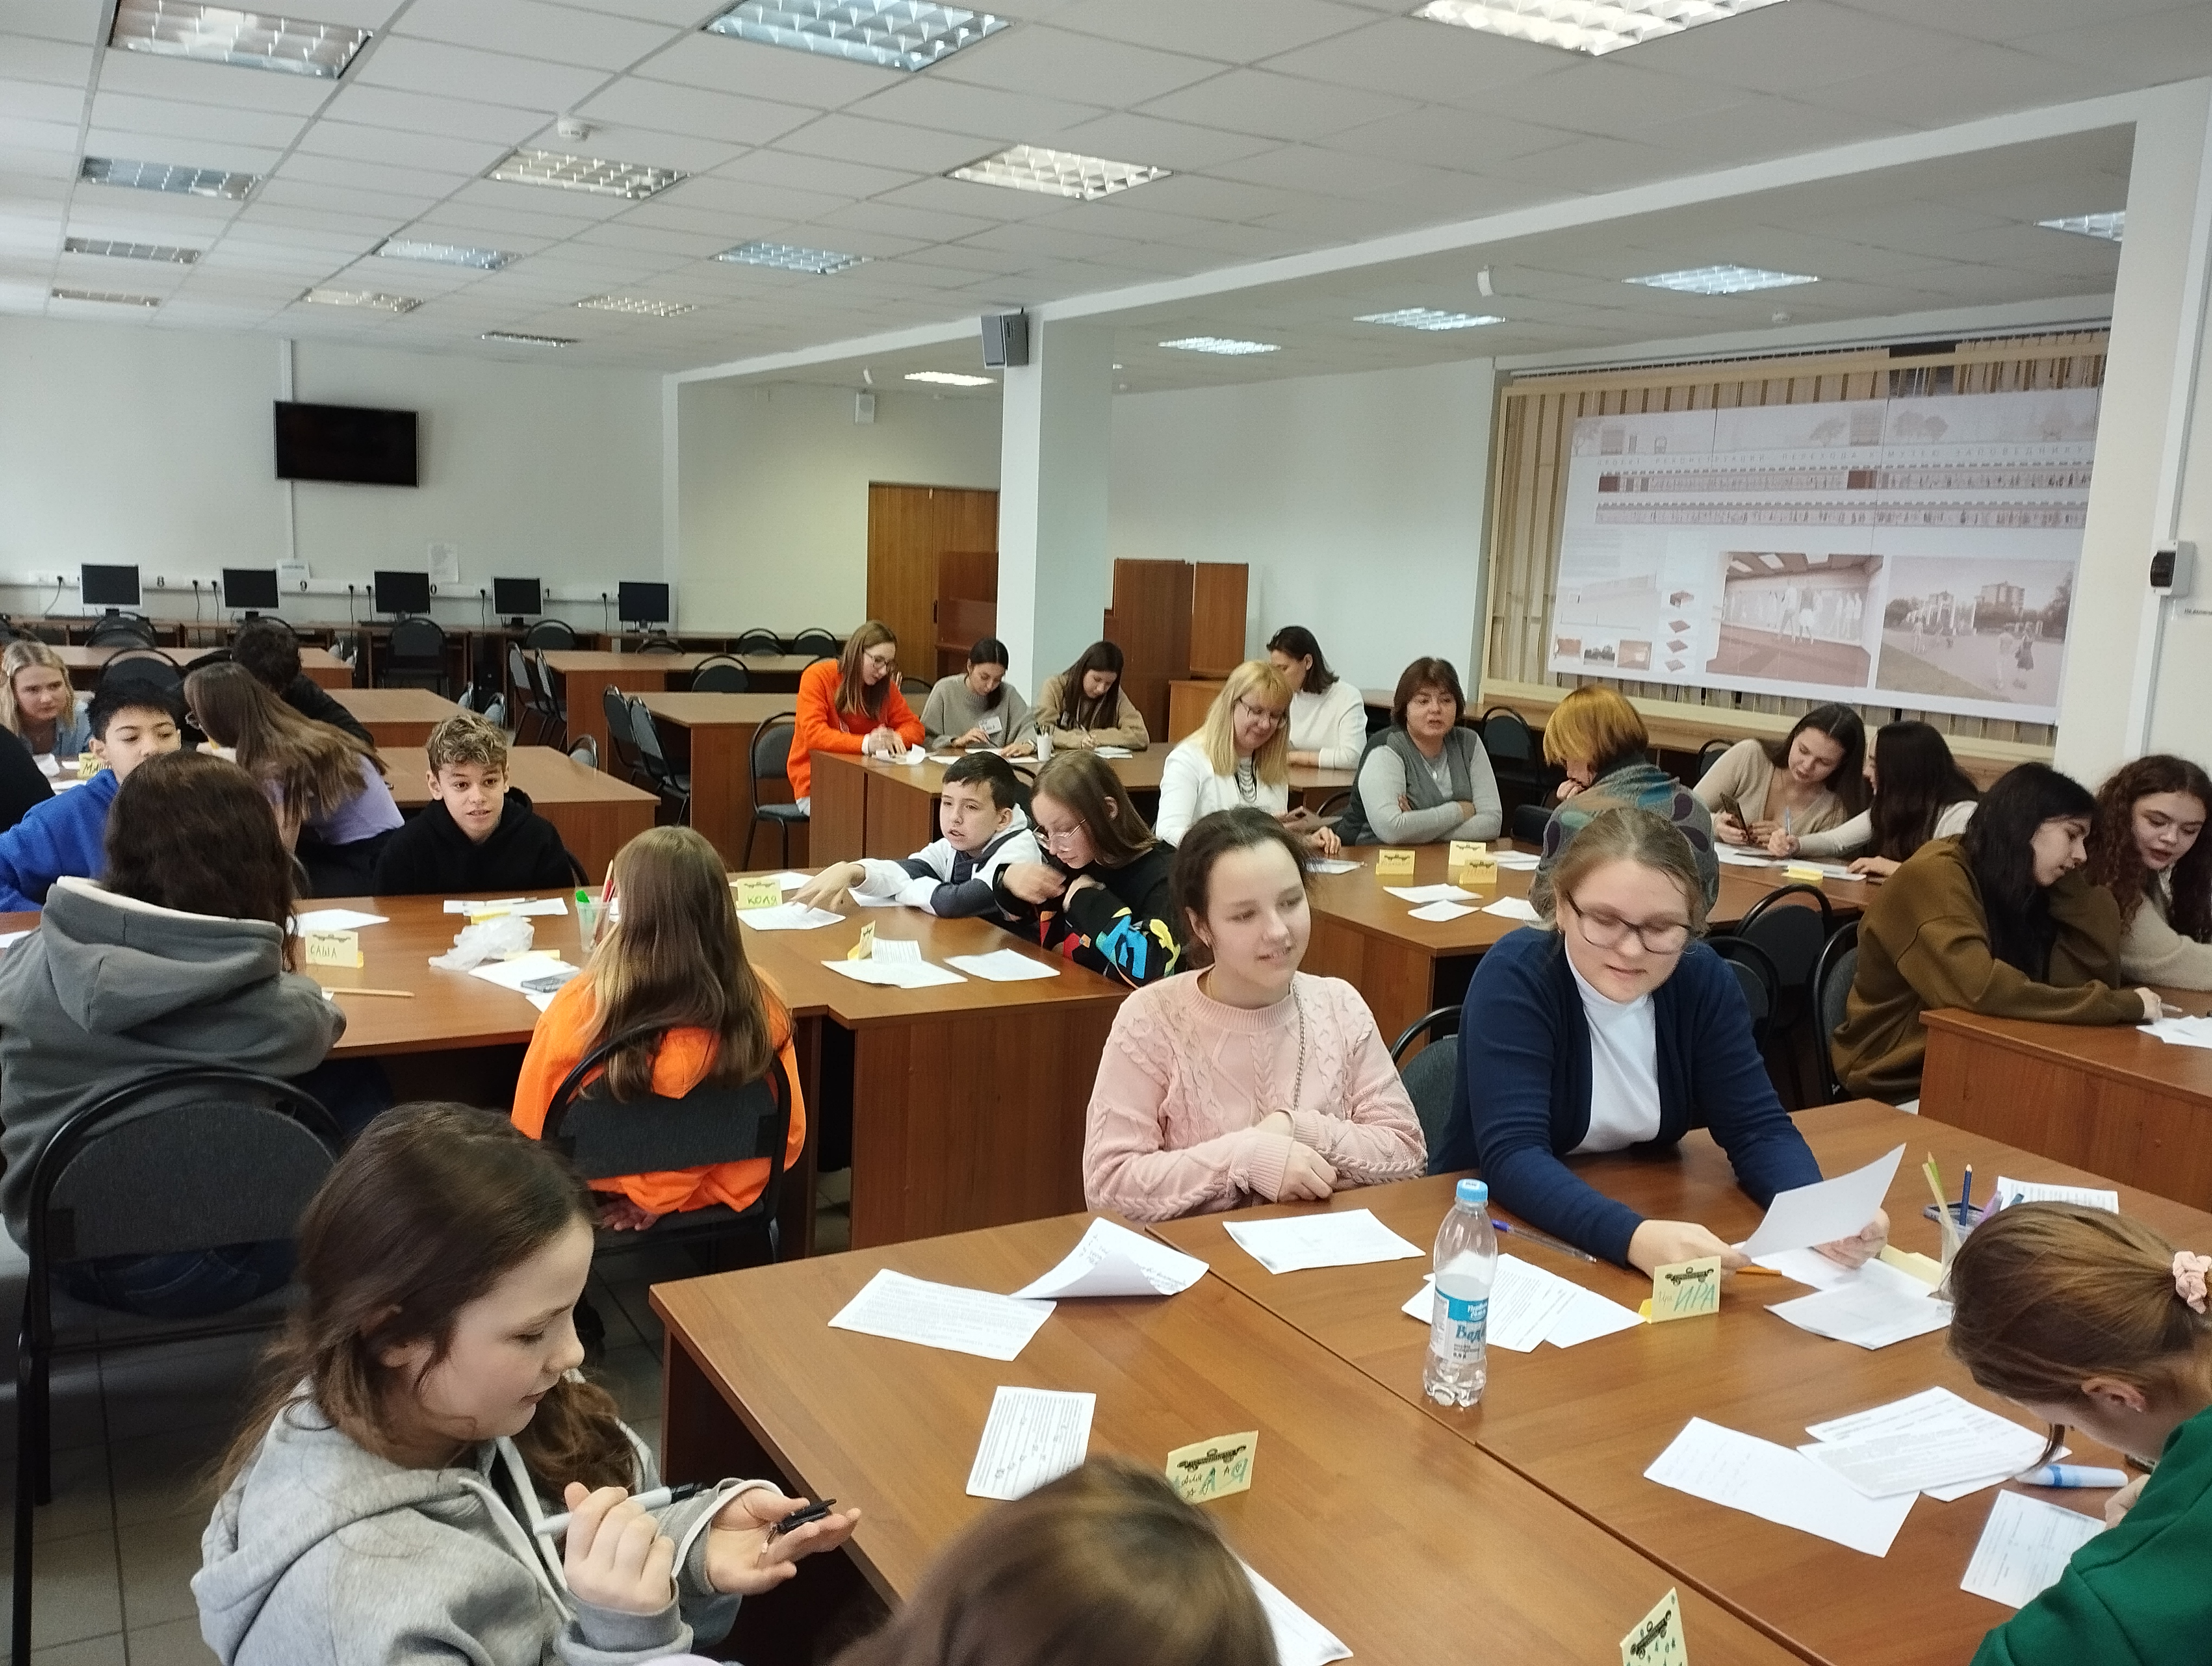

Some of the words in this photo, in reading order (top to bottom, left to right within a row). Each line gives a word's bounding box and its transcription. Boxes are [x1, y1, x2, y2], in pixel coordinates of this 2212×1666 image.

[747, 895, 777, 906] КОЛЯ
[310, 943, 337, 959] САША
[1674, 1282, 1716, 1312] ИРА
